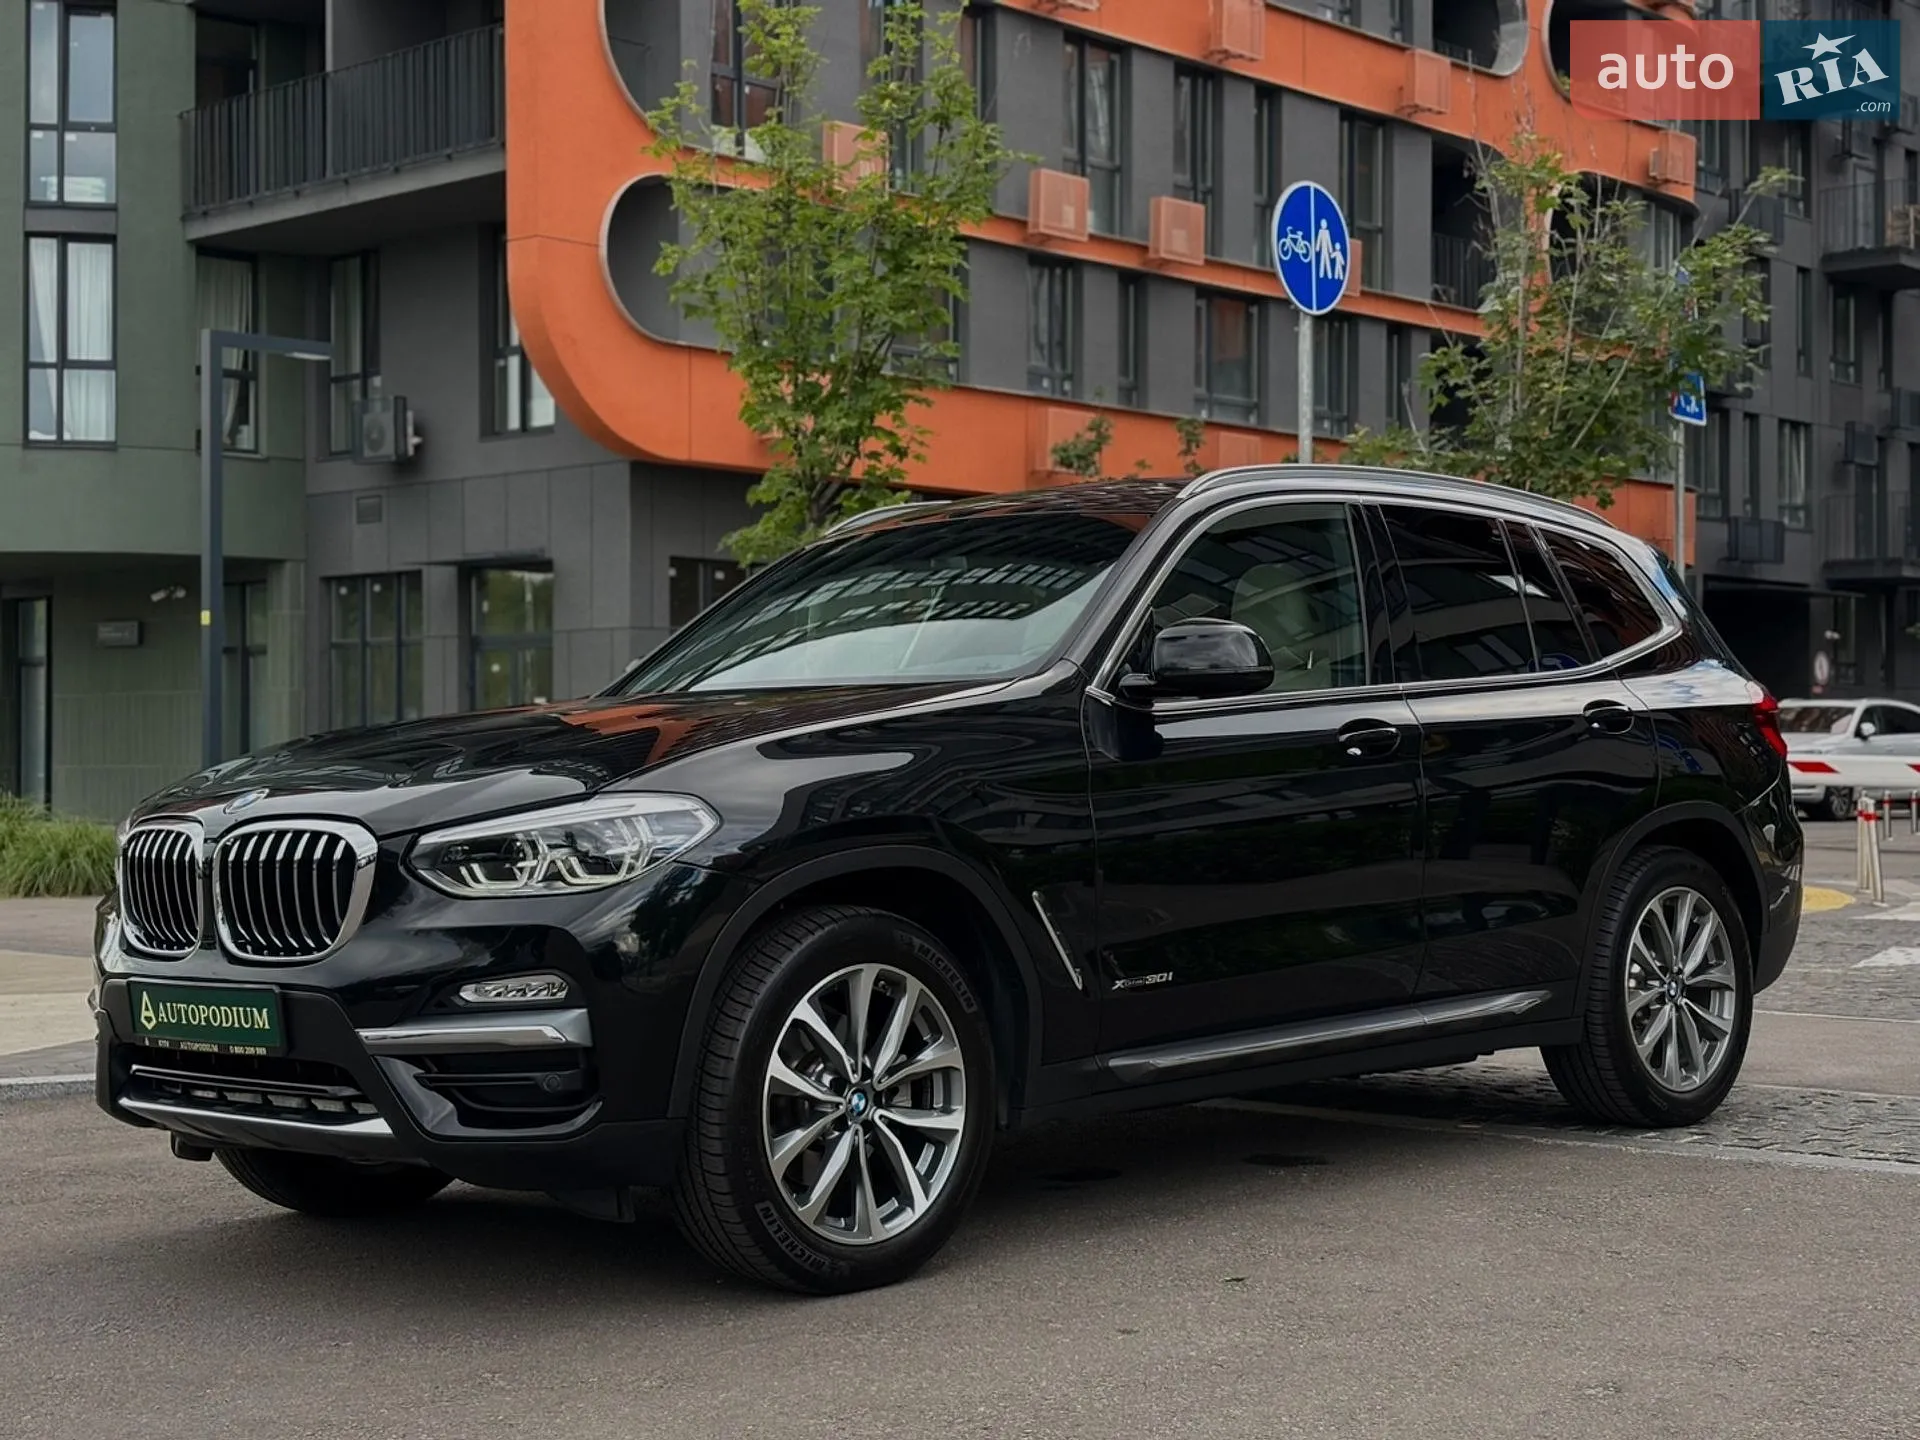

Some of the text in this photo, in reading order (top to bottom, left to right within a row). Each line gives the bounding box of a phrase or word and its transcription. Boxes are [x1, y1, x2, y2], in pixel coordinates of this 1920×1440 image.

[916, 943, 976, 1012] MICHELIN
[157, 1002, 271, 1029] AUTOPODIUM
[757, 1205, 827, 1272] MICHELIN
